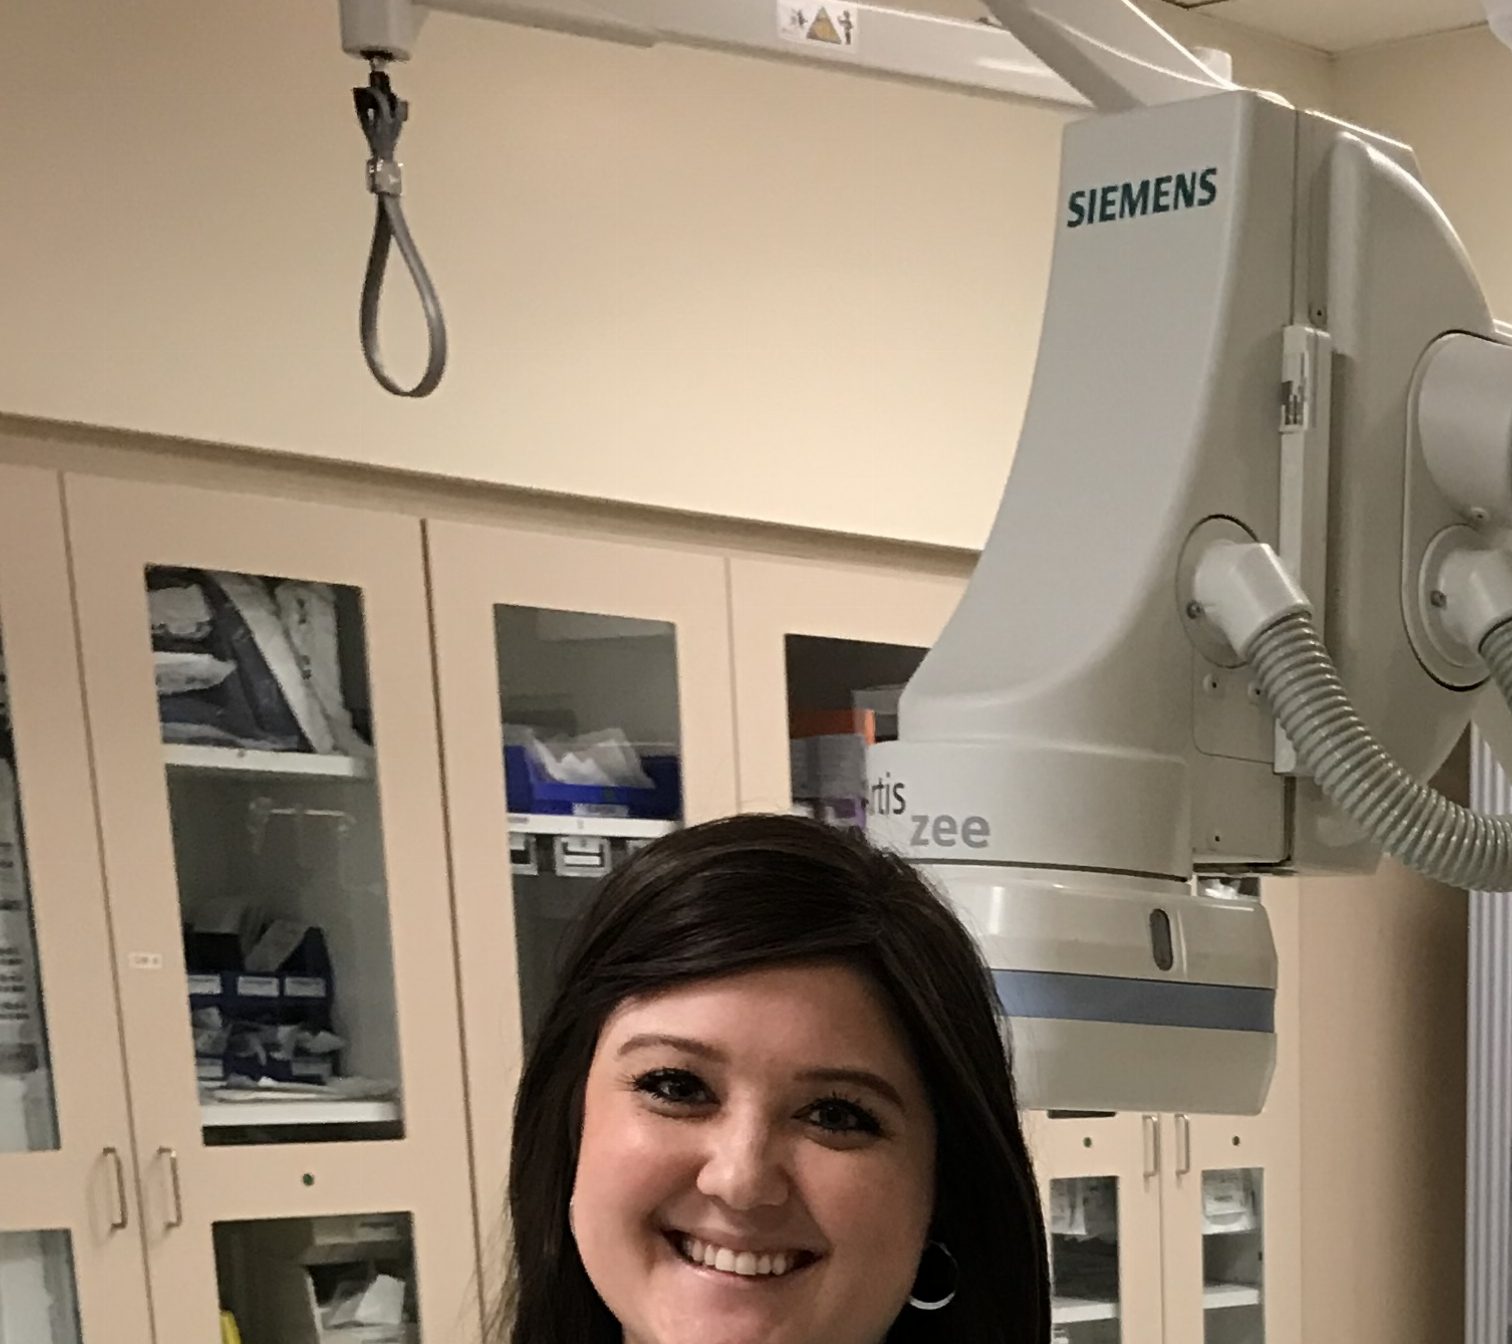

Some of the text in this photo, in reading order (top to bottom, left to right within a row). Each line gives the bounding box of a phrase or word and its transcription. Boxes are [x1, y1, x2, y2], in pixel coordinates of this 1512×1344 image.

[1067, 167, 1217, 228] SIEMENS
[870, 771, 905, 816] rtis
[910, 814, 991, 849] zee
